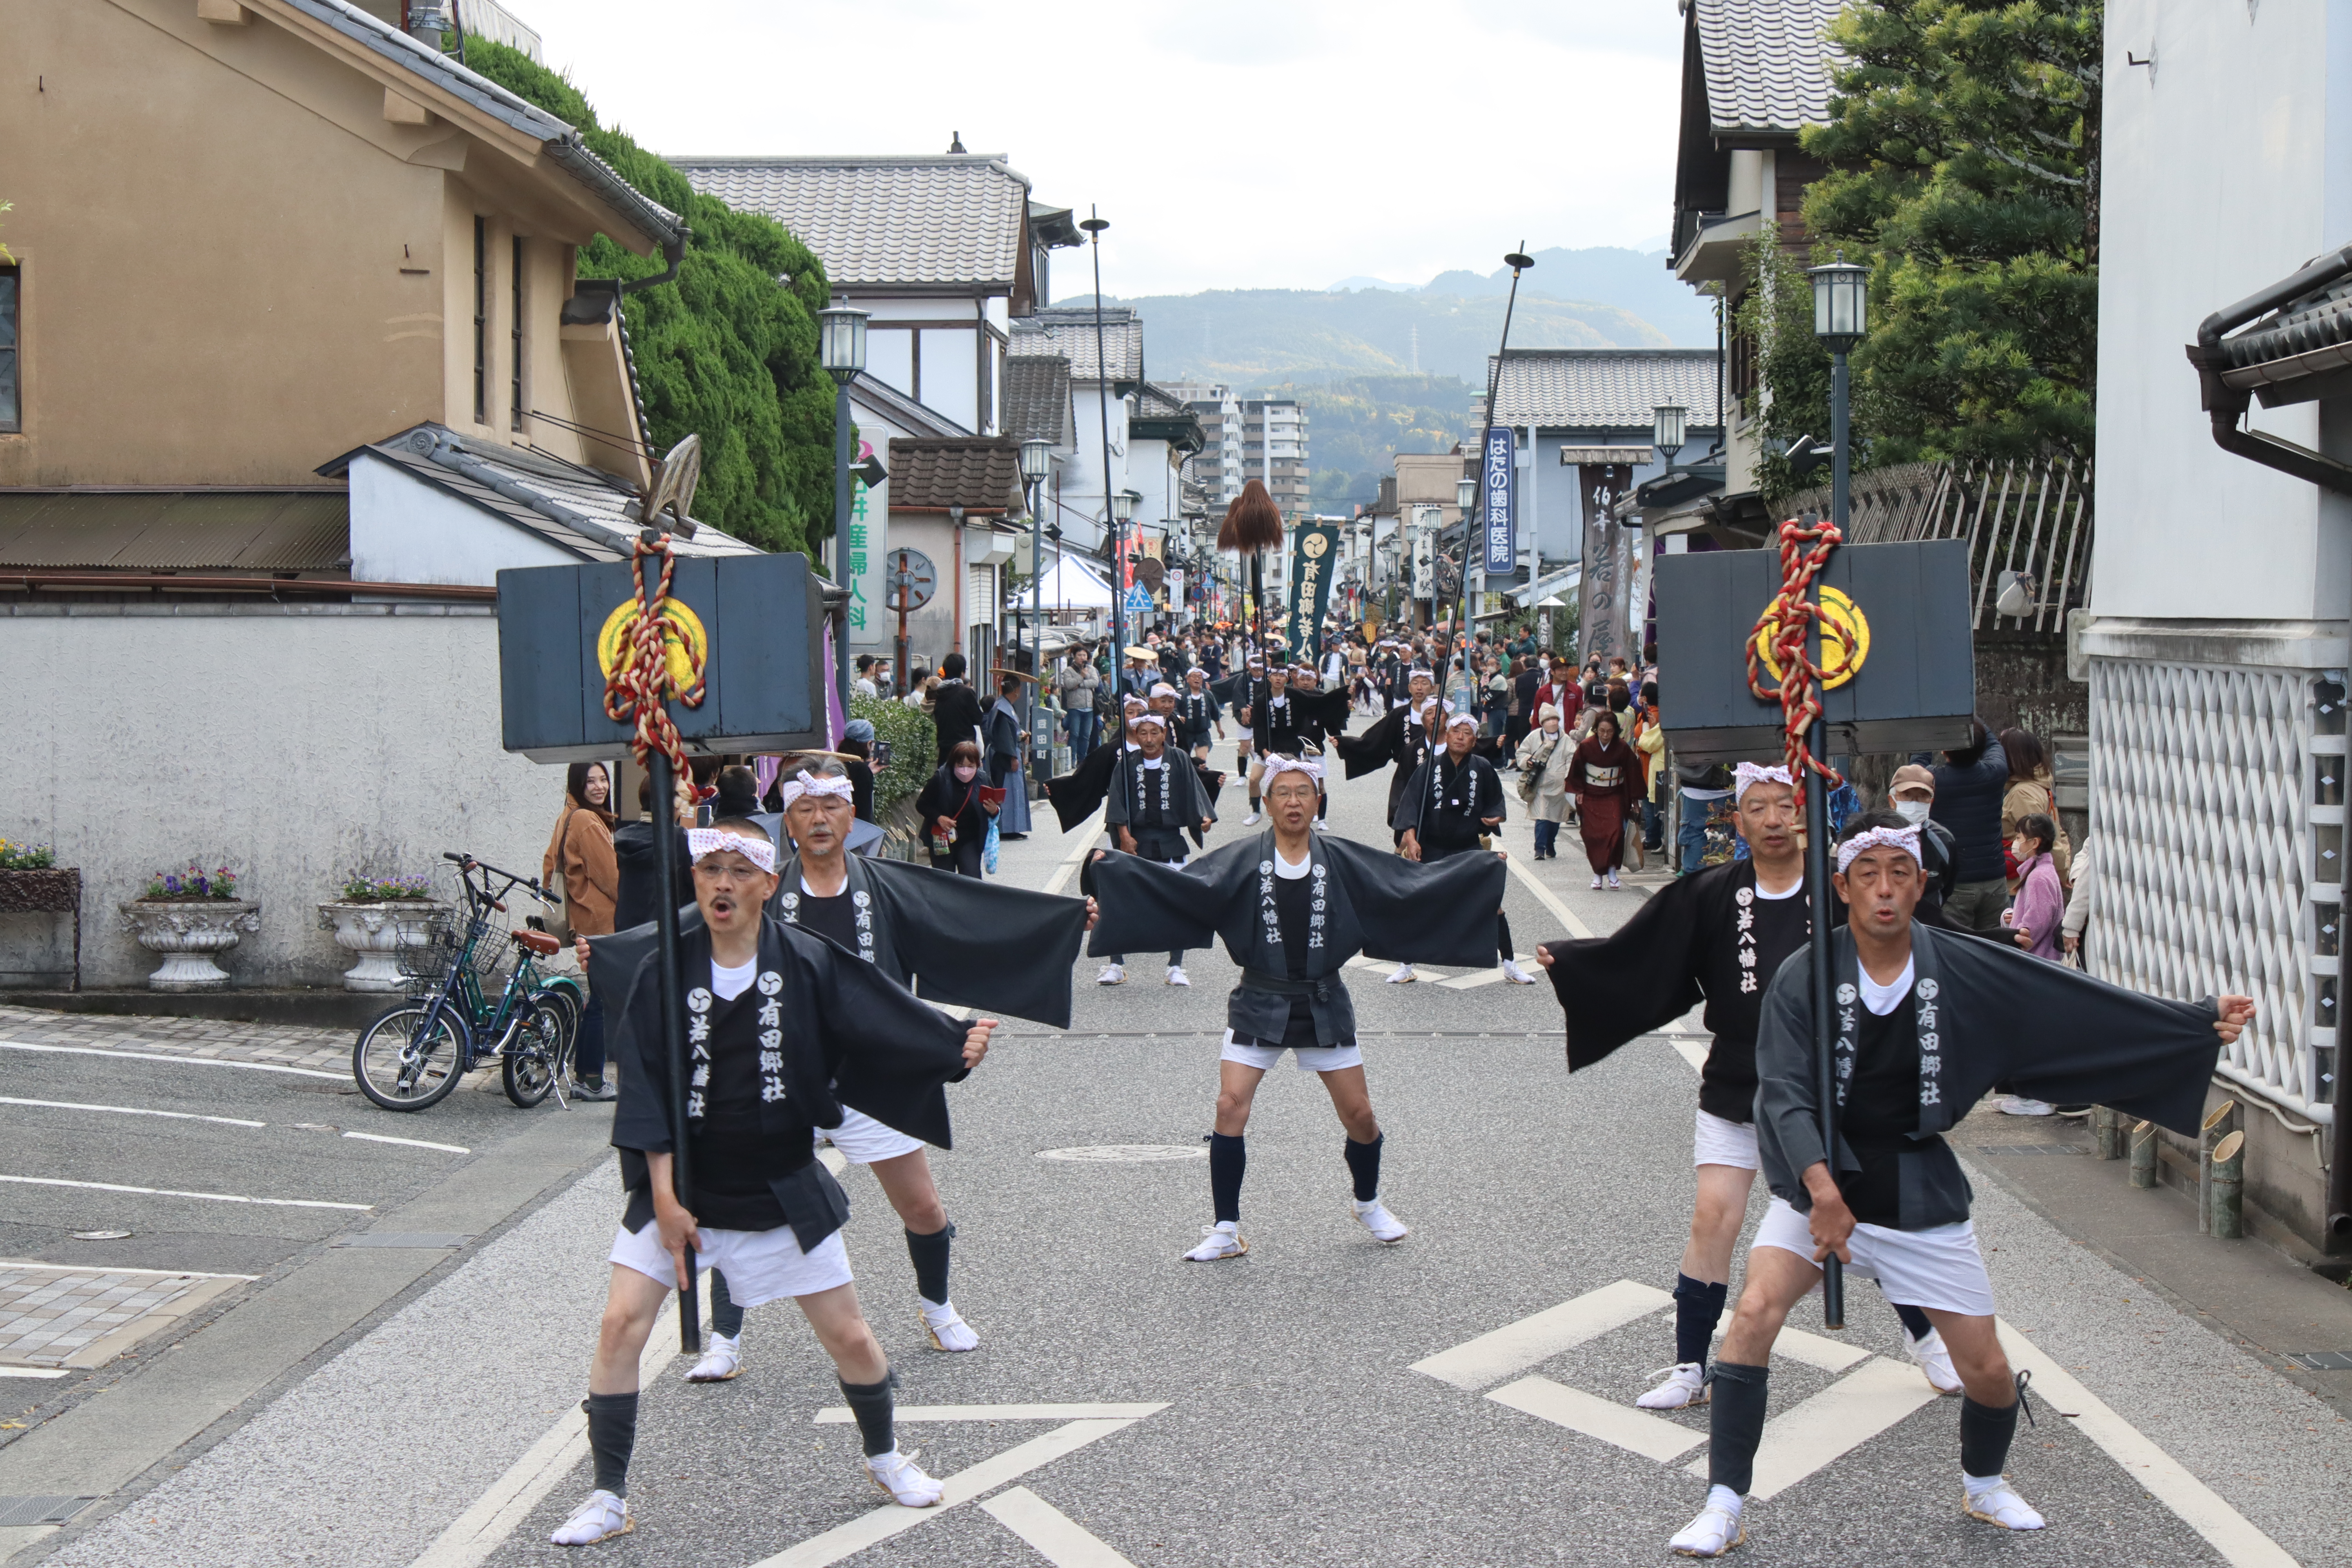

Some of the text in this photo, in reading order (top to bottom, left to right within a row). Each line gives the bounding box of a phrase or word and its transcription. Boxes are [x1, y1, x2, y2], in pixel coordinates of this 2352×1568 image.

[1490, 437, 1509, 563] はたの歯科医院
[849, 478, 868, 631] 井産婦人科
[1417, 512, 1432, 592] 天領まの駅
[1036, 719, 1047, 760] 豆田町
[1136, 773, 1147, 810] 若八幡社
[1160, 771, 1170, 809] 有田郷社
[1259, 876, 1282, 944] 若八幡社
[1308, 878, 1327, 949] 有田郷社
[1737, 907, 1757, 994] 若八幡社
[758, 997, 786, 1103] 有田郷社
[1917, 1002, 1941, 1106] 有田郷社
